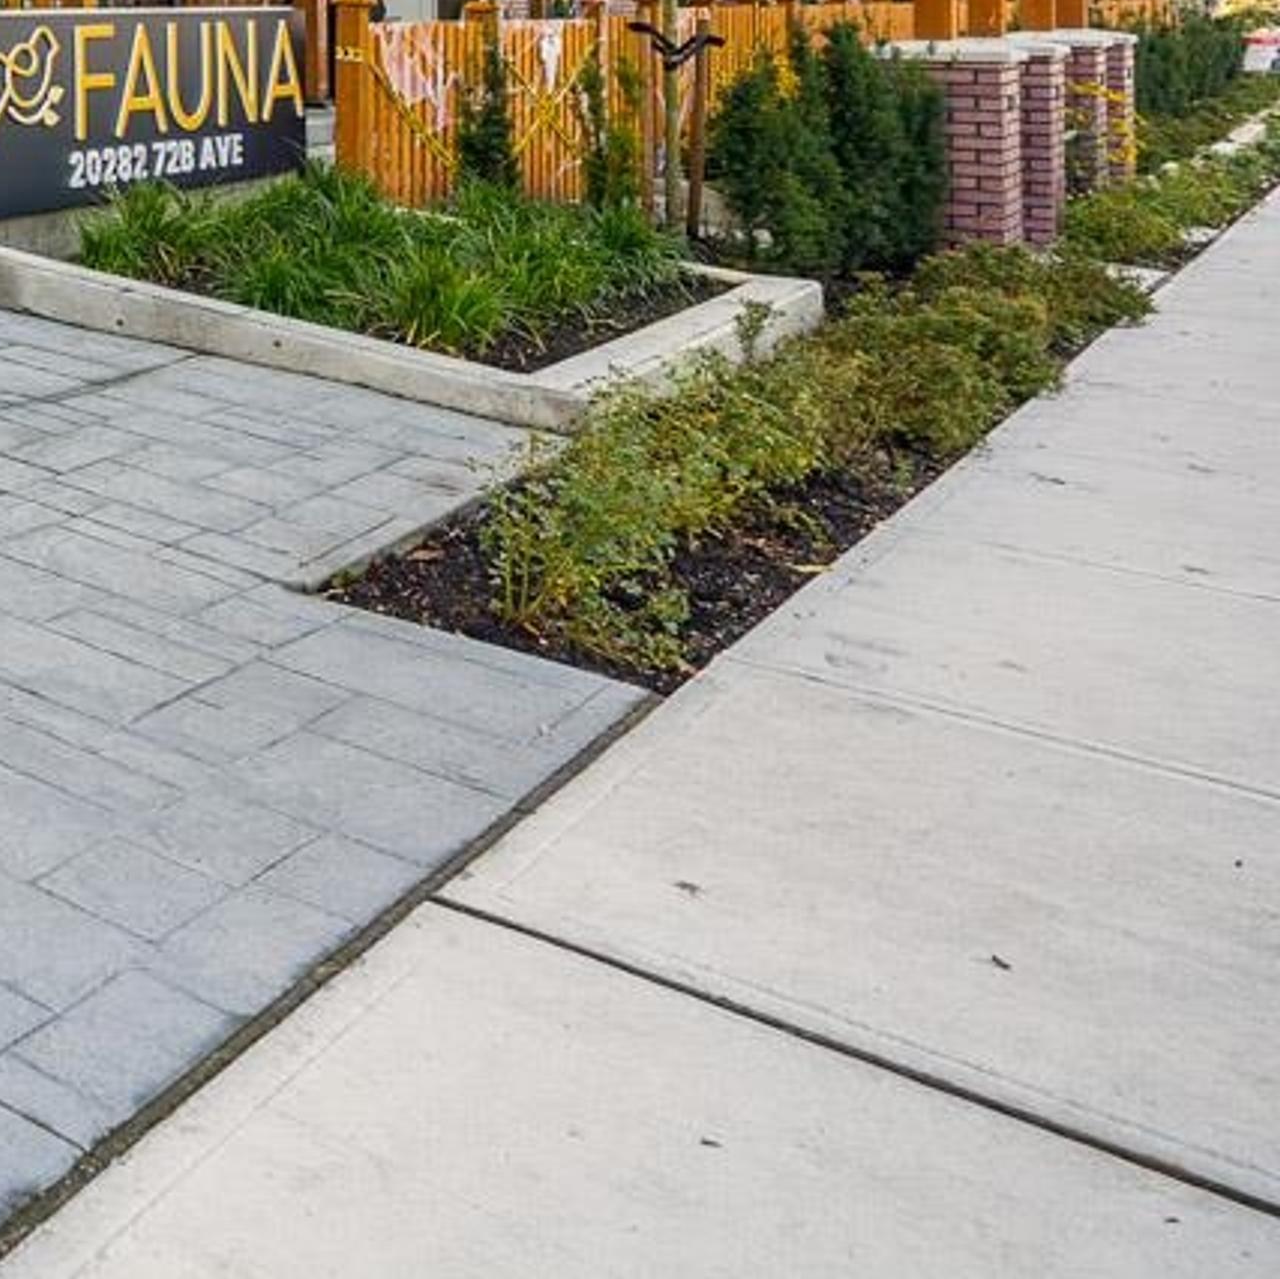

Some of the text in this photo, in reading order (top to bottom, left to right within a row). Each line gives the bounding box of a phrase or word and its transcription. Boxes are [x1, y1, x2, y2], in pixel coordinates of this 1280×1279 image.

[73, 19, 304, 140] FAUNA
[68, 133, 244, 189] 20282 72B AVE
